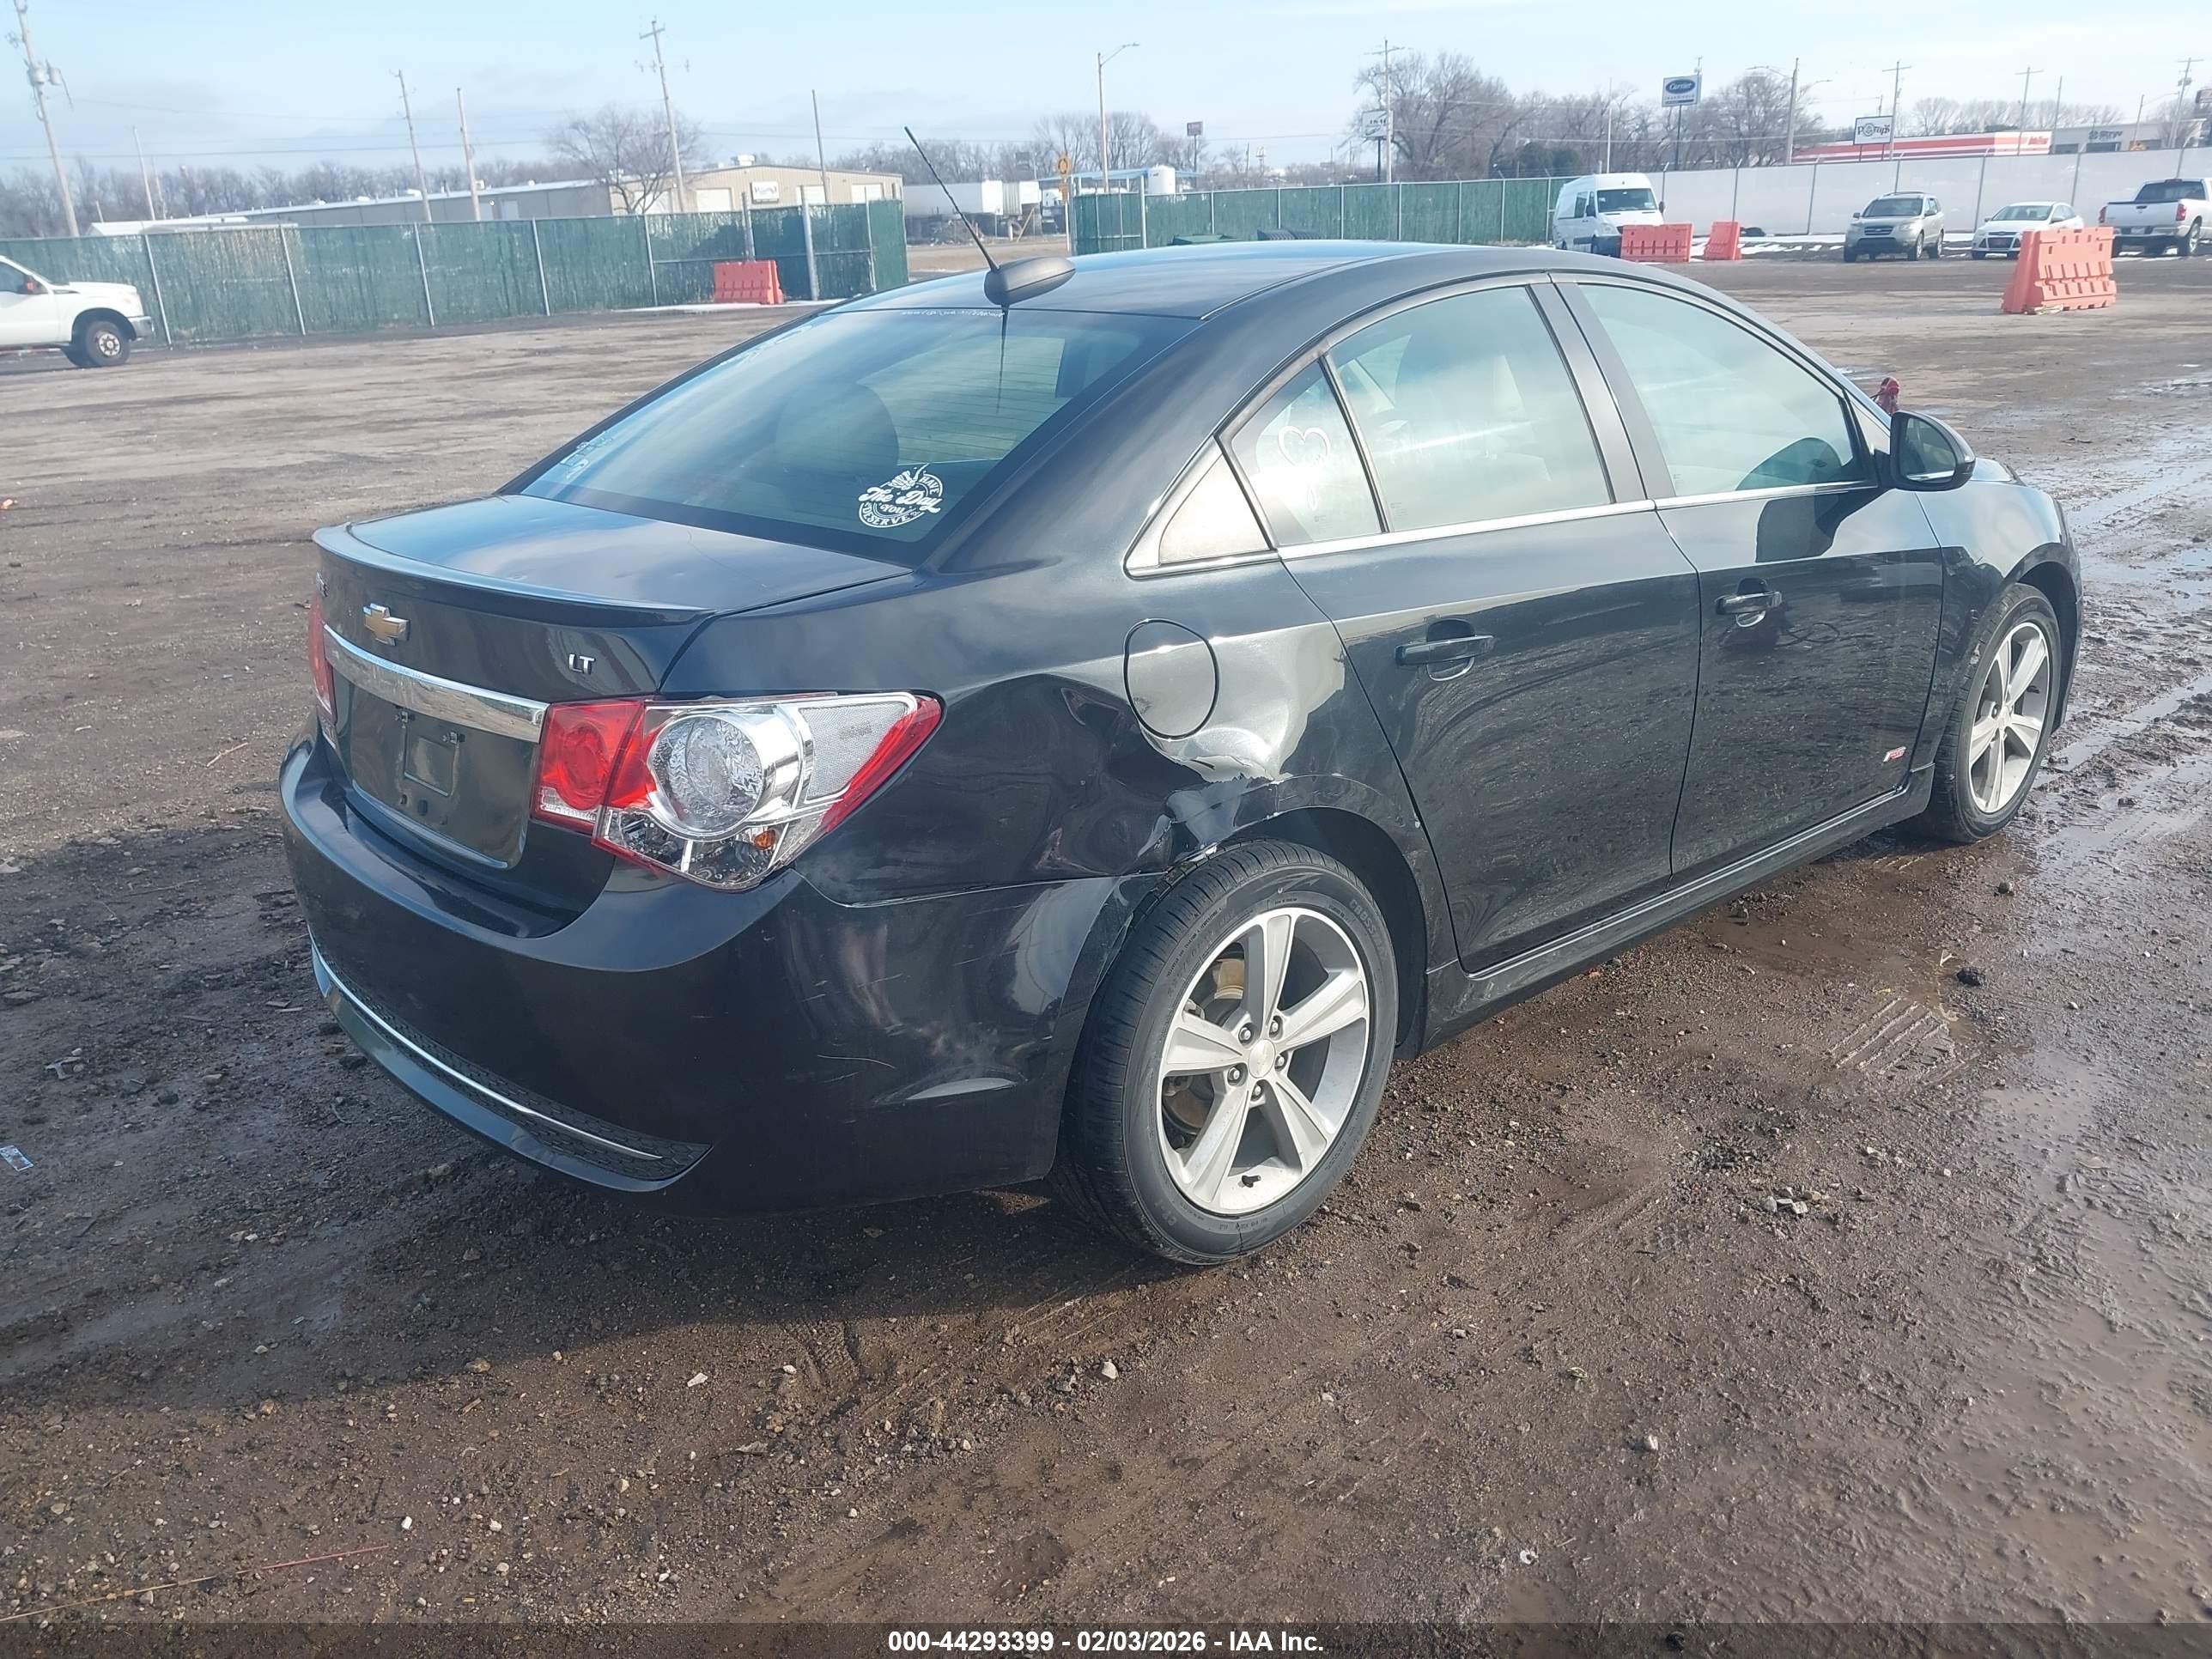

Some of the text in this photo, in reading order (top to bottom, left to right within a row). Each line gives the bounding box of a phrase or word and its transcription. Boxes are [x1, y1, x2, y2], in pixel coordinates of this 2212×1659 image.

[919, 476, 939, 495] HAVE
[859, 487, 943, 514] The Day
[862, 506, 910, 526] DESERVE
[568, 653, 595, 674] LT
